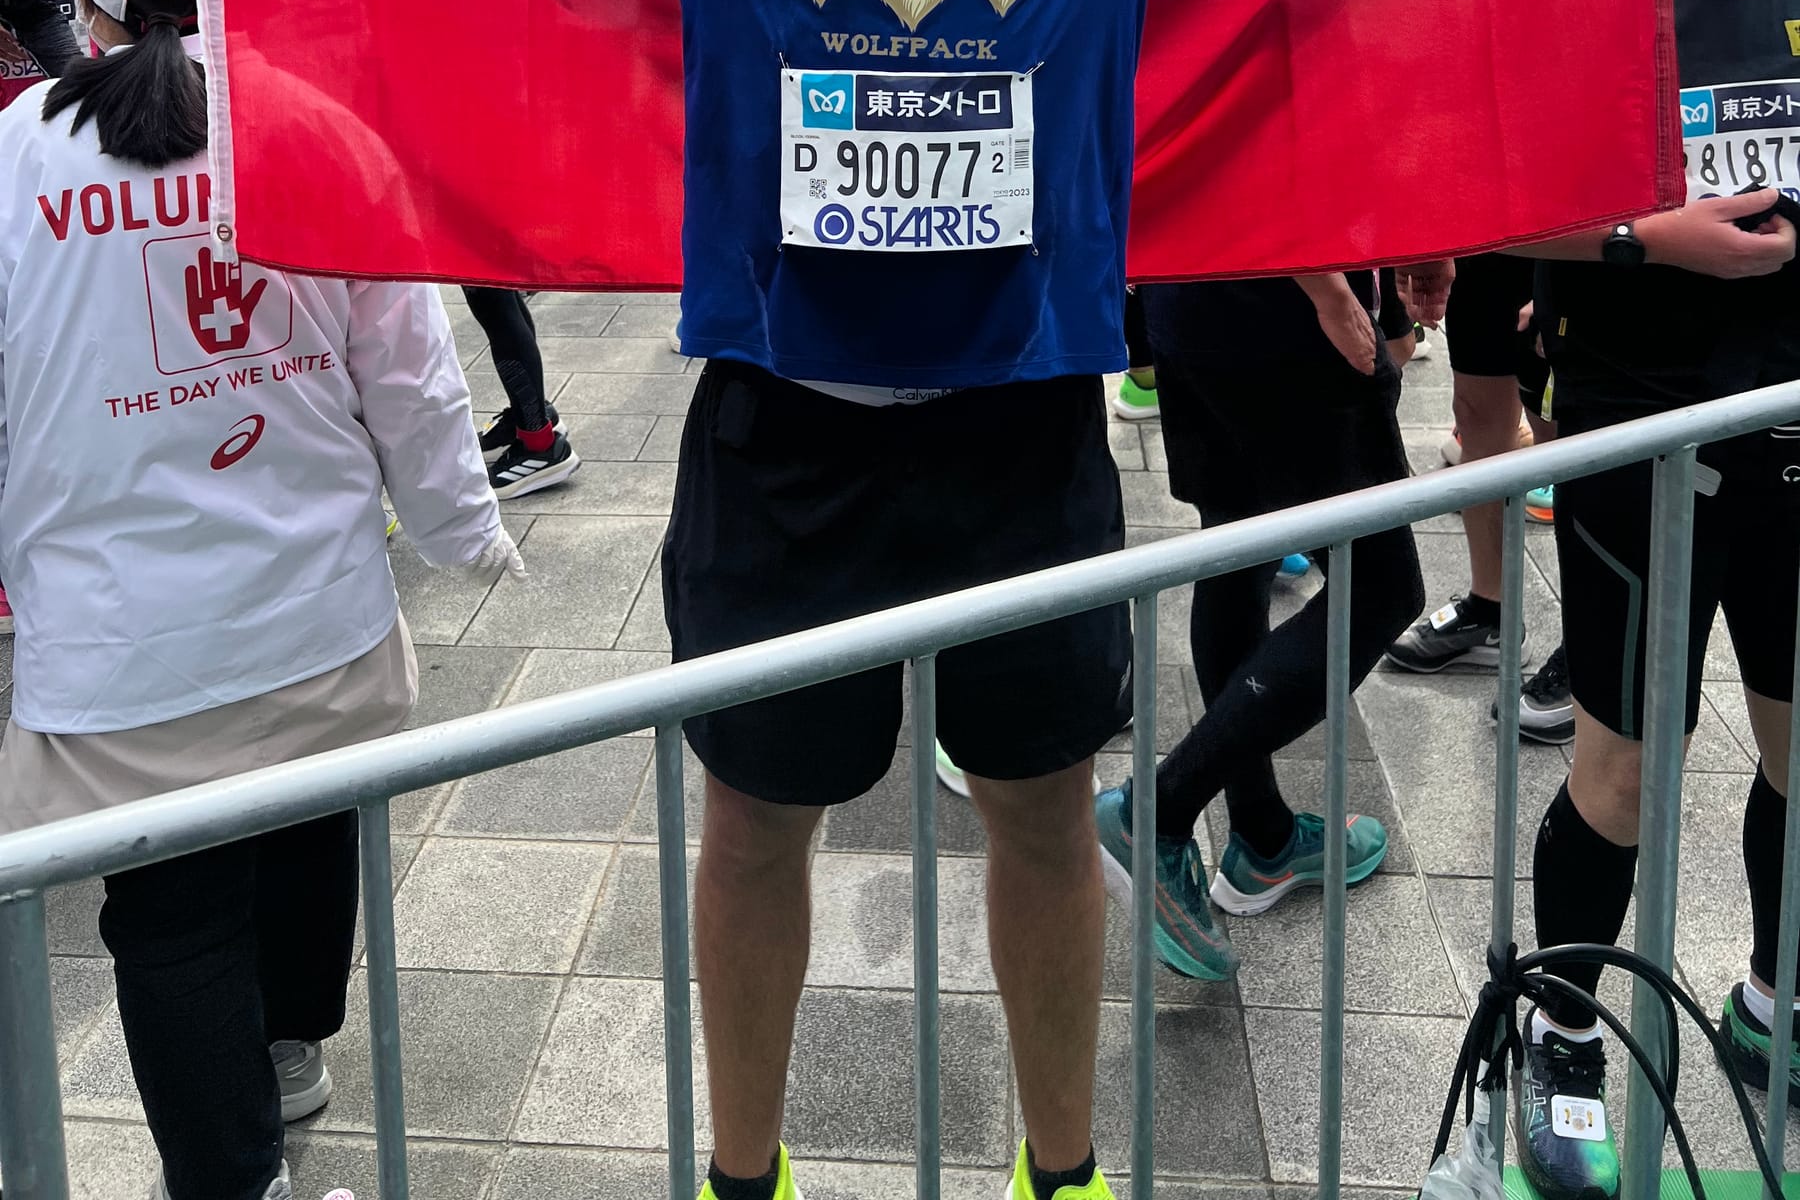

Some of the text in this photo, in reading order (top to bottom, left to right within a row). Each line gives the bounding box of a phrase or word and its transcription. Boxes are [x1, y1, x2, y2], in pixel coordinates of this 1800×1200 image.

[821, 31, 998, 61] WOLFPACK
[866, 89, 1001, 118] 東京メトロ
[794, 143, 818, 172] D
[836, 140, 981, 199] 90077
[991, 152, 1004, 174] 2
[1009, 188, 1030, 197] 2023
[105, 352, 335, 418] THE DAY WE UNITE.
[893, 387, 941, 401] Calvin
